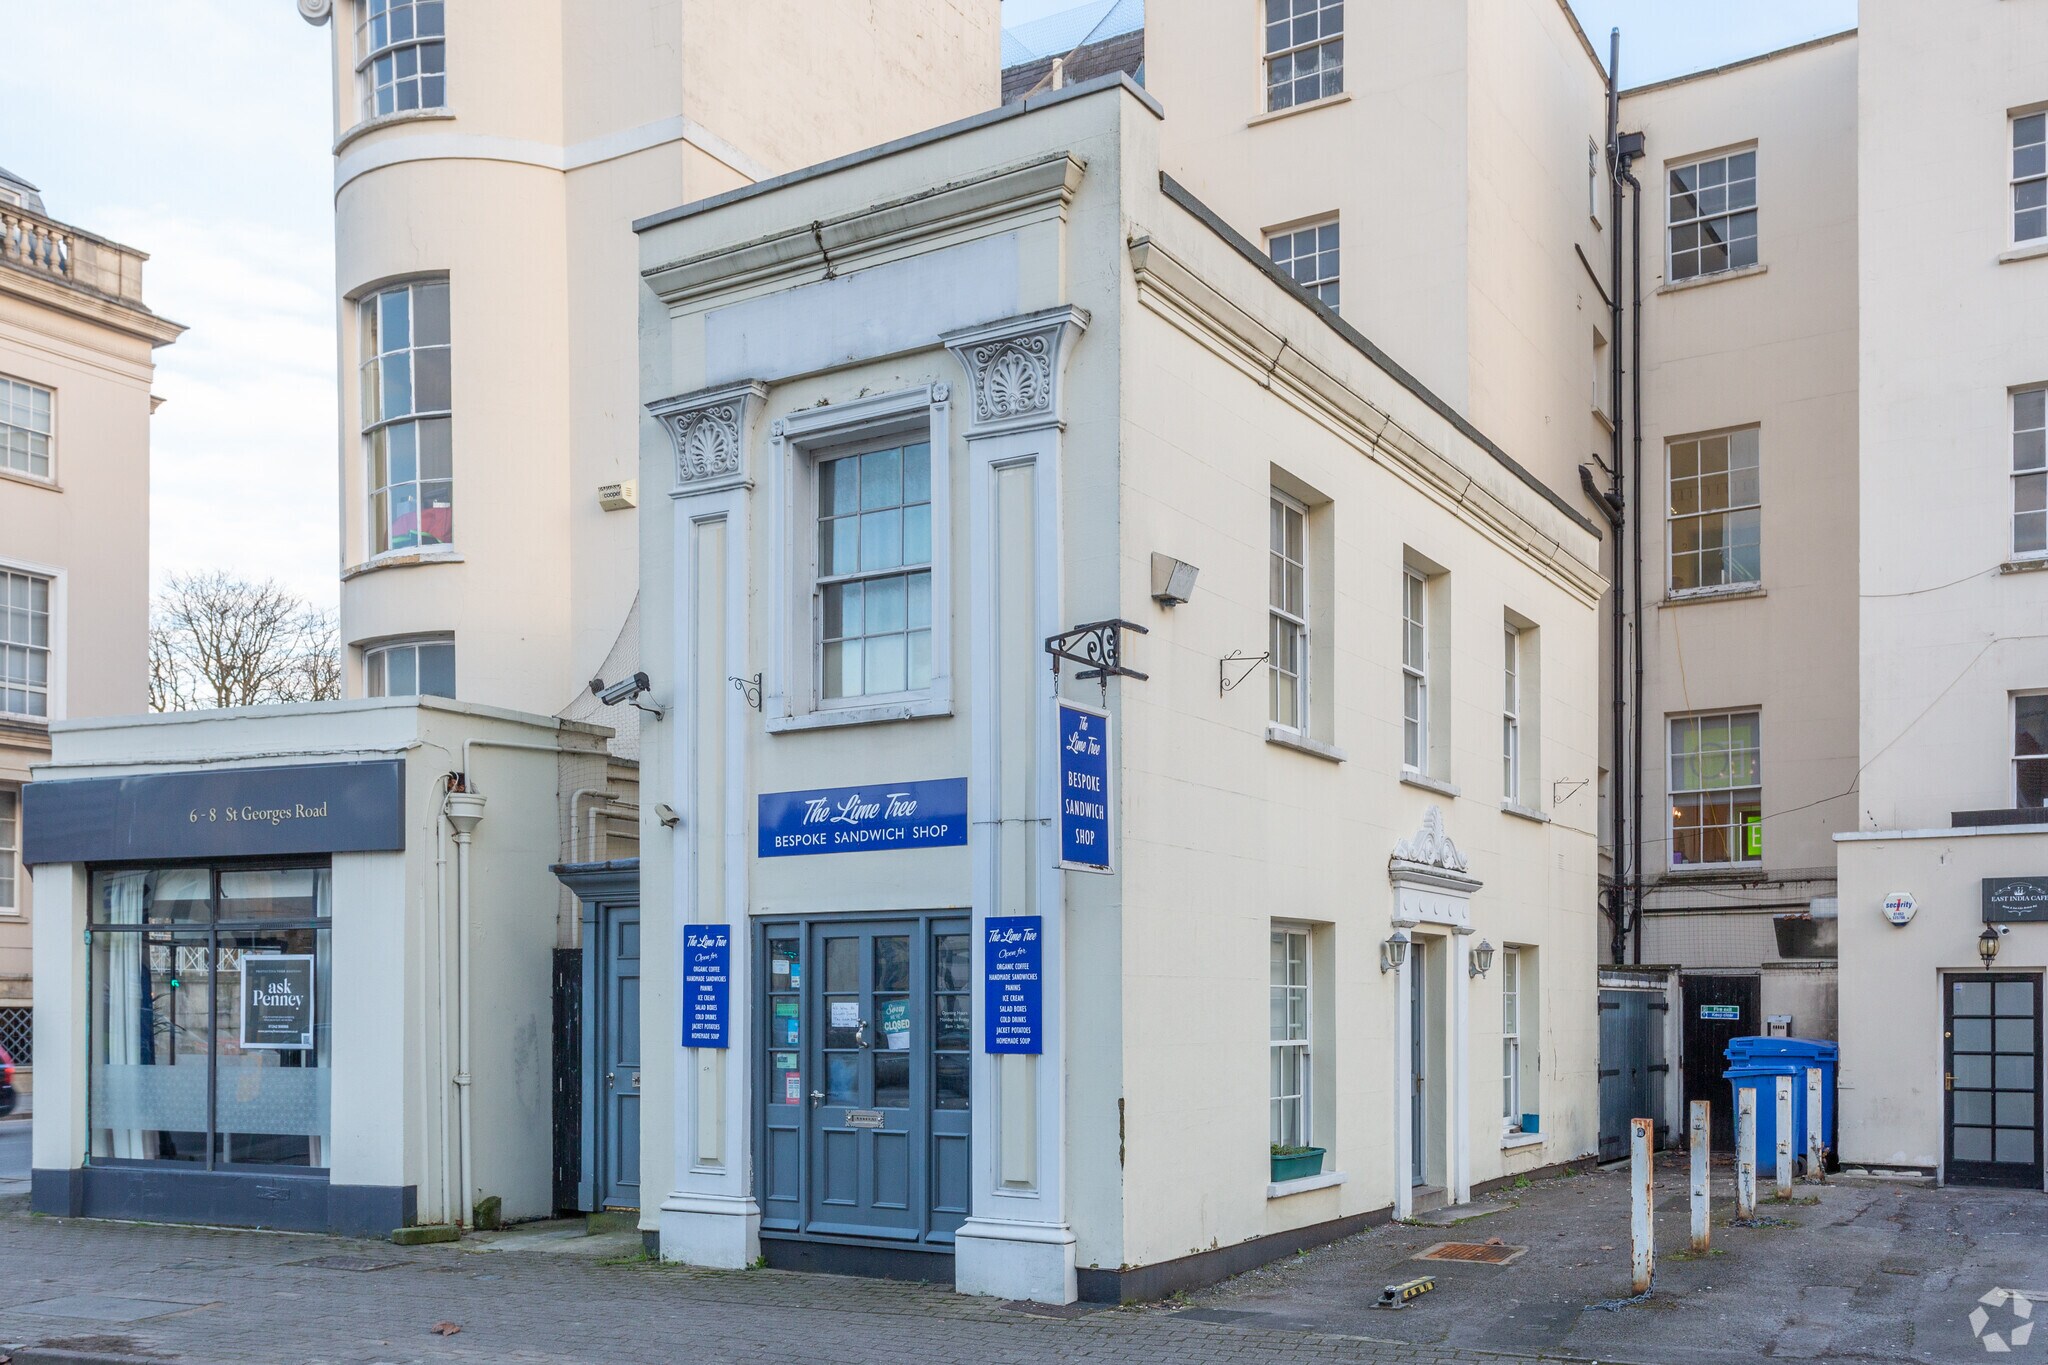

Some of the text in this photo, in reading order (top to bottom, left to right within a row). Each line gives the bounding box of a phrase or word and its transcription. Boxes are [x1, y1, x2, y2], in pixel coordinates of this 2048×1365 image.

[1079, 716, 1088, 731] The
[1066, 731, 1101, 756] Lime Tree
[1068, 771, 1101, 792] BESPOKE
[225, 807, 238, 821] St
[241, 806, 292, 826] Georges
[295, 801, 328, 819] Road
[803, 792, 918, 825] The Lime Tree
[1065, 798, 1104, 820] SANDWICH
[775, 824, 949, 848] BESPOKE SANDWICH SHOP
[1075, 828, 1095, 845] SHOP
[687, 934, 727, 949] The Lime Tree
[989, 928, 1037, 944] The Lime Tree
[998, 947, 1027, 959] Open for
[1014, 962, 1029, 970] COFFEE
[1011, 972, 1038, 980] SANDWICHES
[268, 977, 292, 994] ask
[253, 989, 304, 1010] Penney
[1009, 994, 1024, 1002] CREAM
[885, 1003, 906, 1017] Sorry
[999, 1005, 1027, 1013] SALAD BOXES
[884, 1018, 910, 1031] CLOSED
[996, 1026, 1031, 1036] JACKET POTATOES
[996, 1037, 1031, 1045] HOMEMADE SOUP
